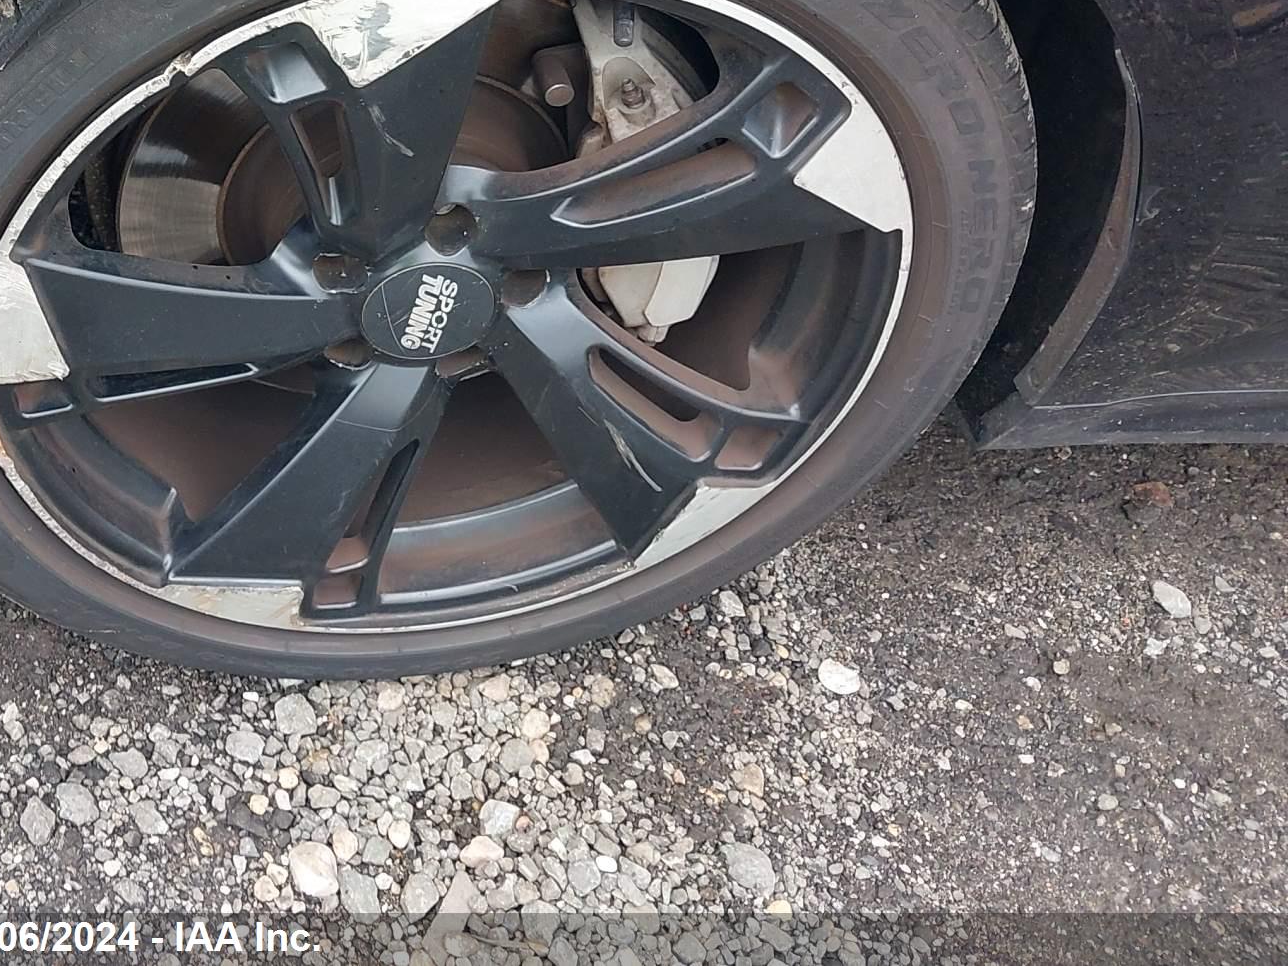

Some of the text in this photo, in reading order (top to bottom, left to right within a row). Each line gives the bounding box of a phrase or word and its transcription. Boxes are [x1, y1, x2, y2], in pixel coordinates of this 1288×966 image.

[958, 158, 1000, 314] NERO
[400, 274, 444, 351] TUNING
[423, 279, 458, 353] SPORT
